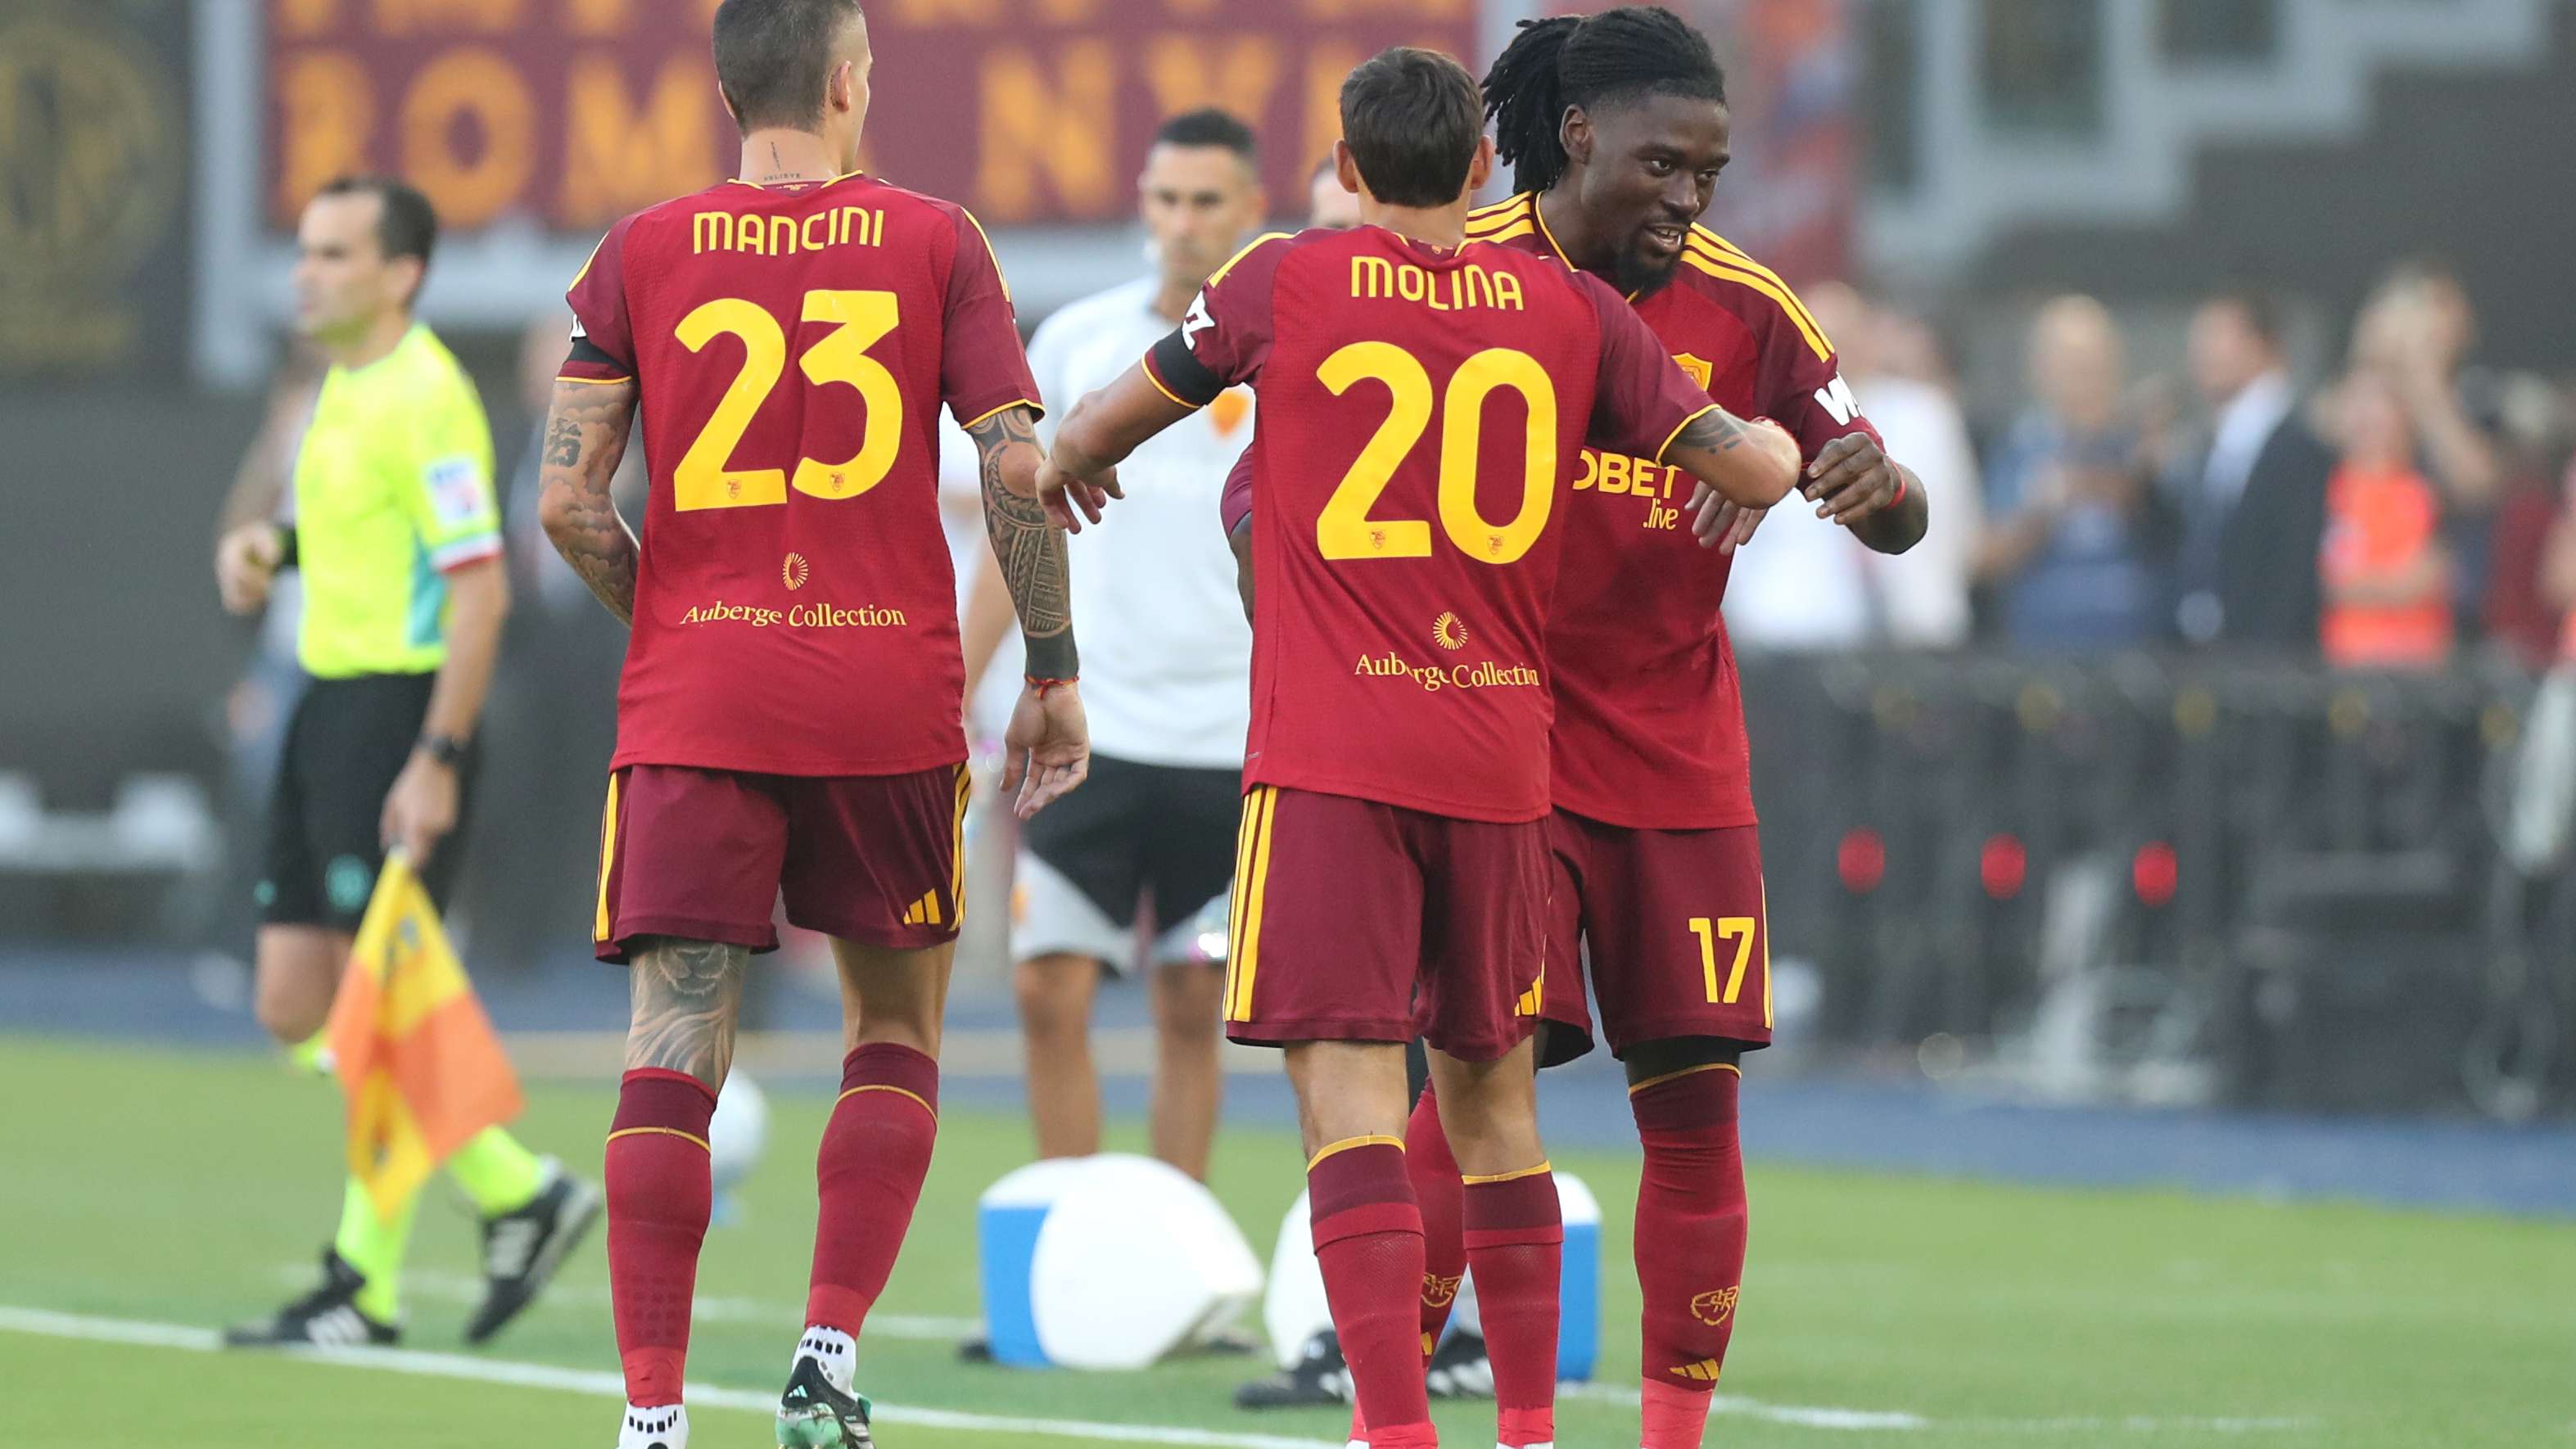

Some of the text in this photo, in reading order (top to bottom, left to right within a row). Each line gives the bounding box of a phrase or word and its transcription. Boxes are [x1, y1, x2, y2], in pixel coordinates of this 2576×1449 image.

[694, 207, 884, 255] MANCINI
[1351, 256, 1523, 310] MOLINA
[674, 290, 902, 512] 23
[1317, 341, 1557, 564] 20
[1643, 498, 1679, 530] .live
[680, 601, 906, 626] Auberge Collection
[1354, 651, 1451, 692] Aubrg
[1689, 917, 1755, 1003] 17
